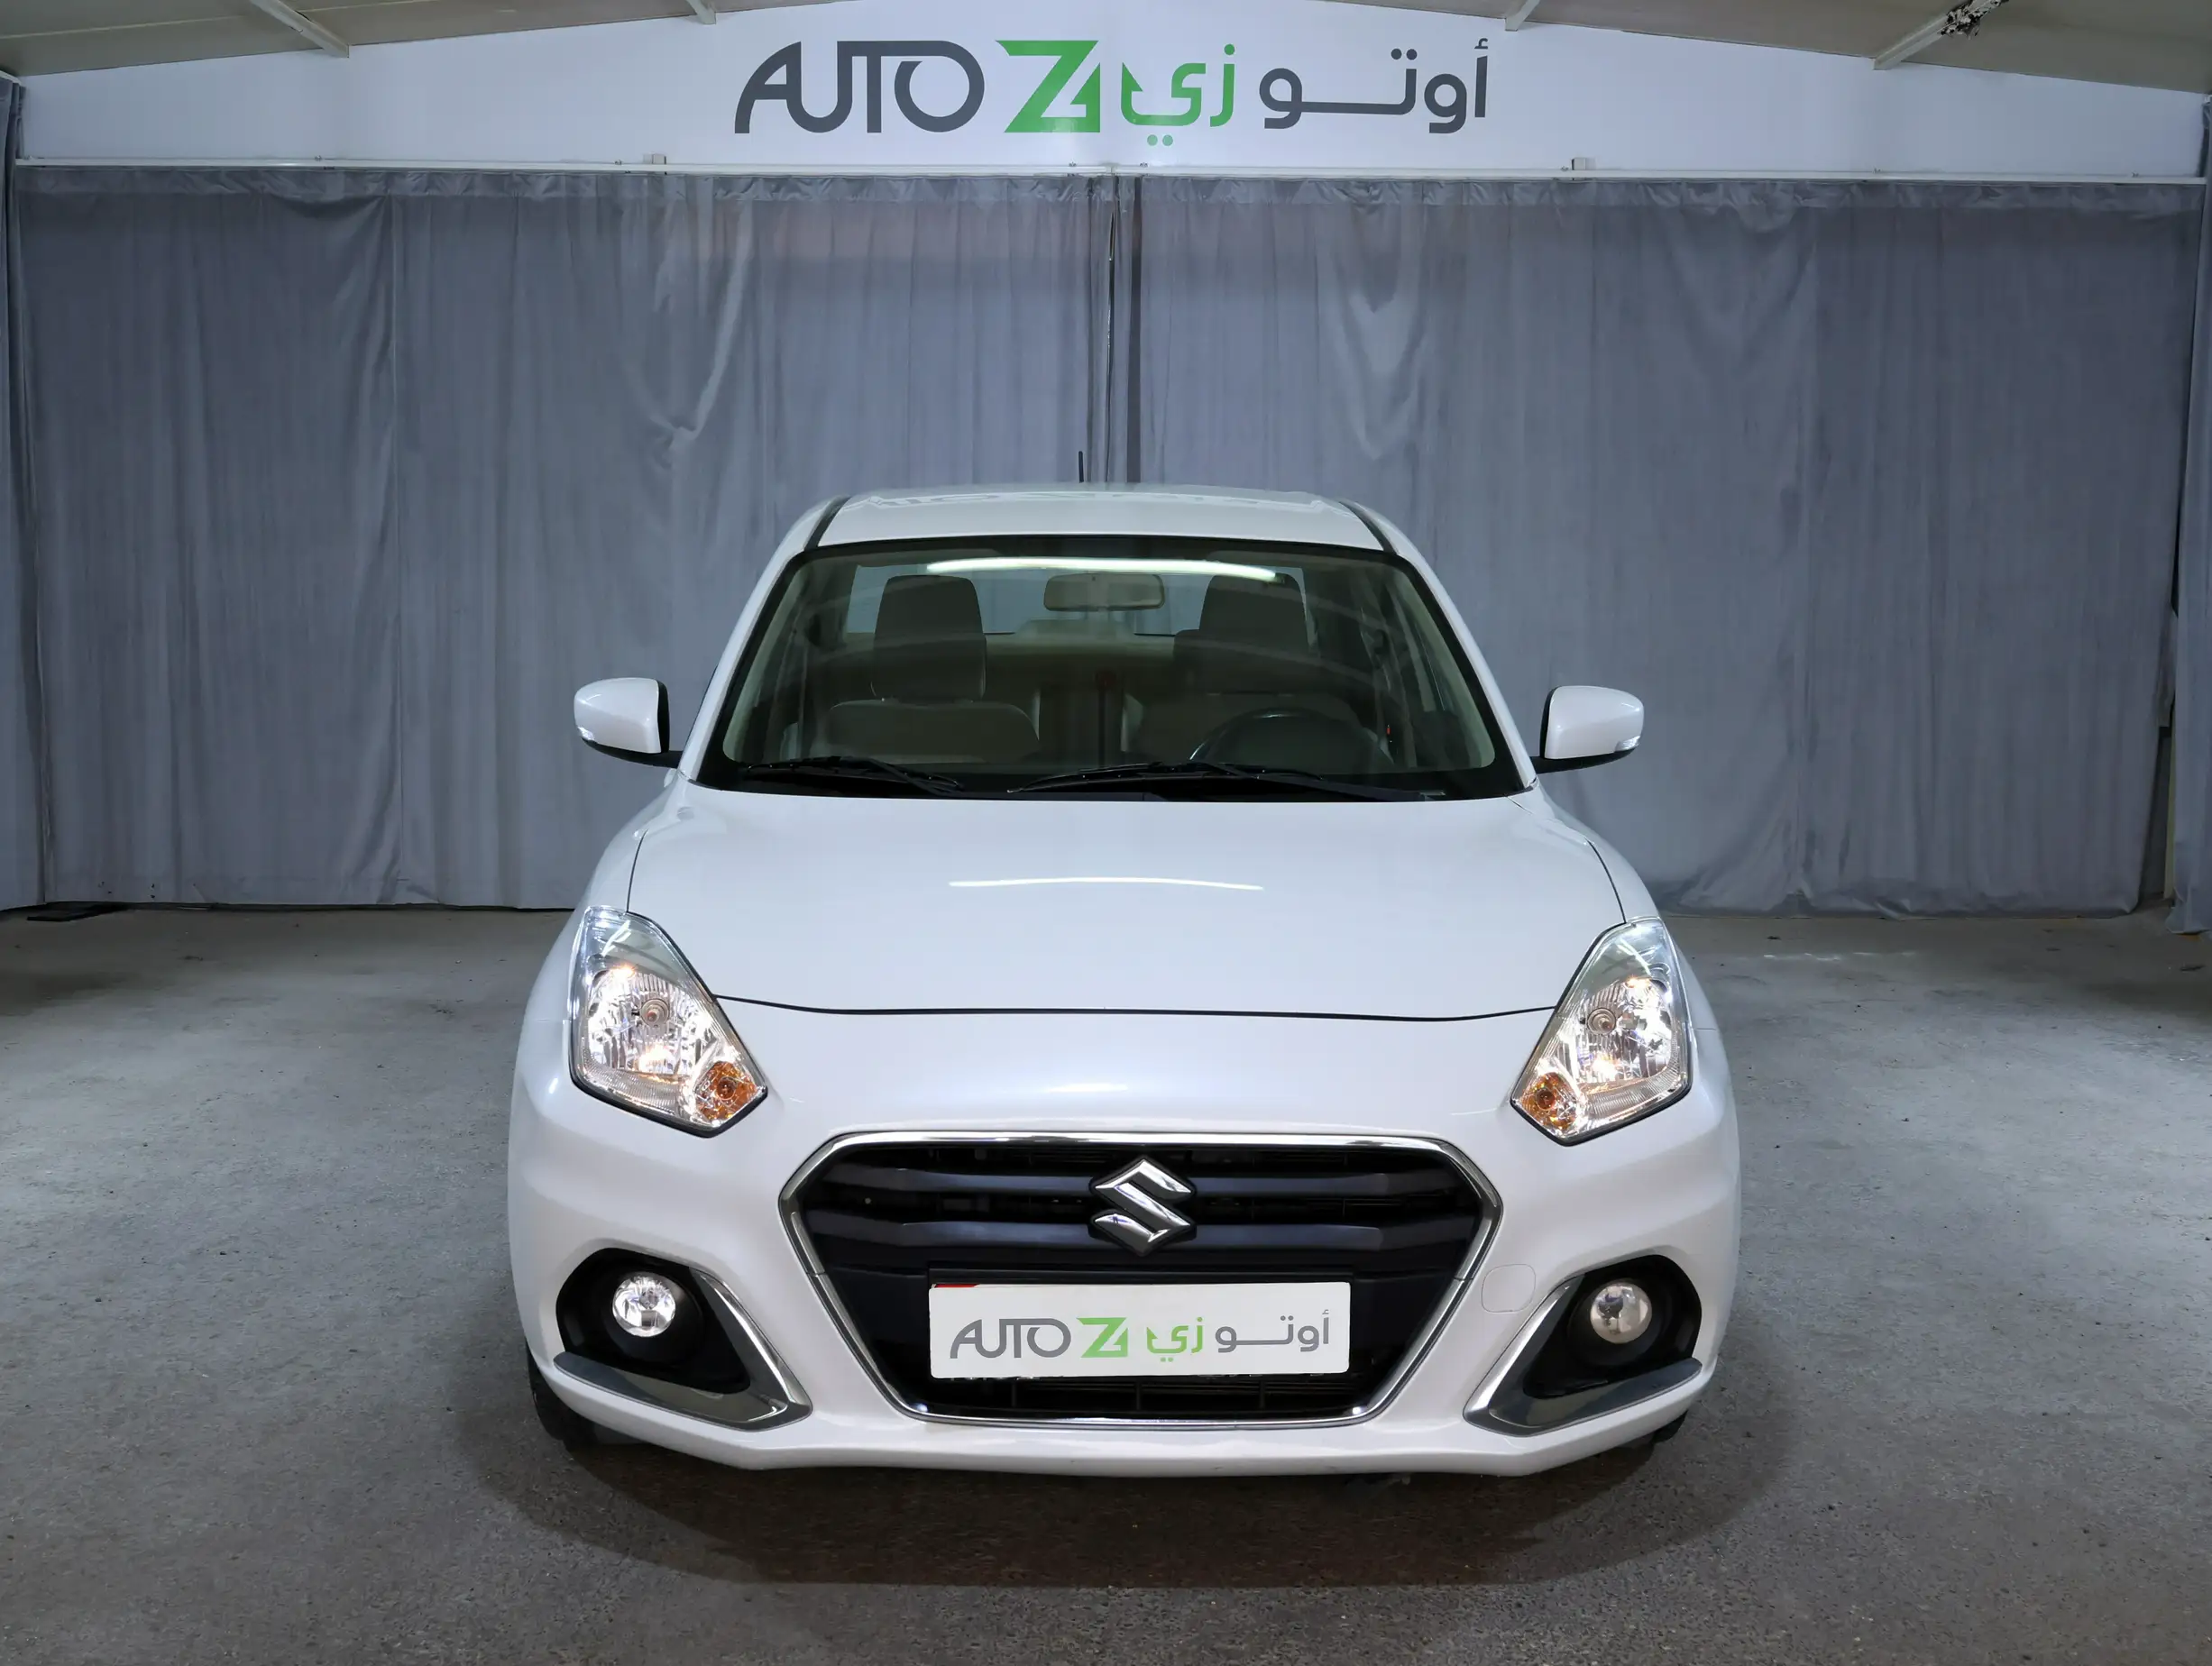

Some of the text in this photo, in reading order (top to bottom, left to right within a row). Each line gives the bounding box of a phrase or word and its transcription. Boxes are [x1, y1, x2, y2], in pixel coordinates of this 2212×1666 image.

[735, 41, 986, 134] AUTO
[1120, 43, 1235, 146] زي
[950, 1317, 1072, 1359] AUTO
[1146, 1316, 1204, 1363] زي
